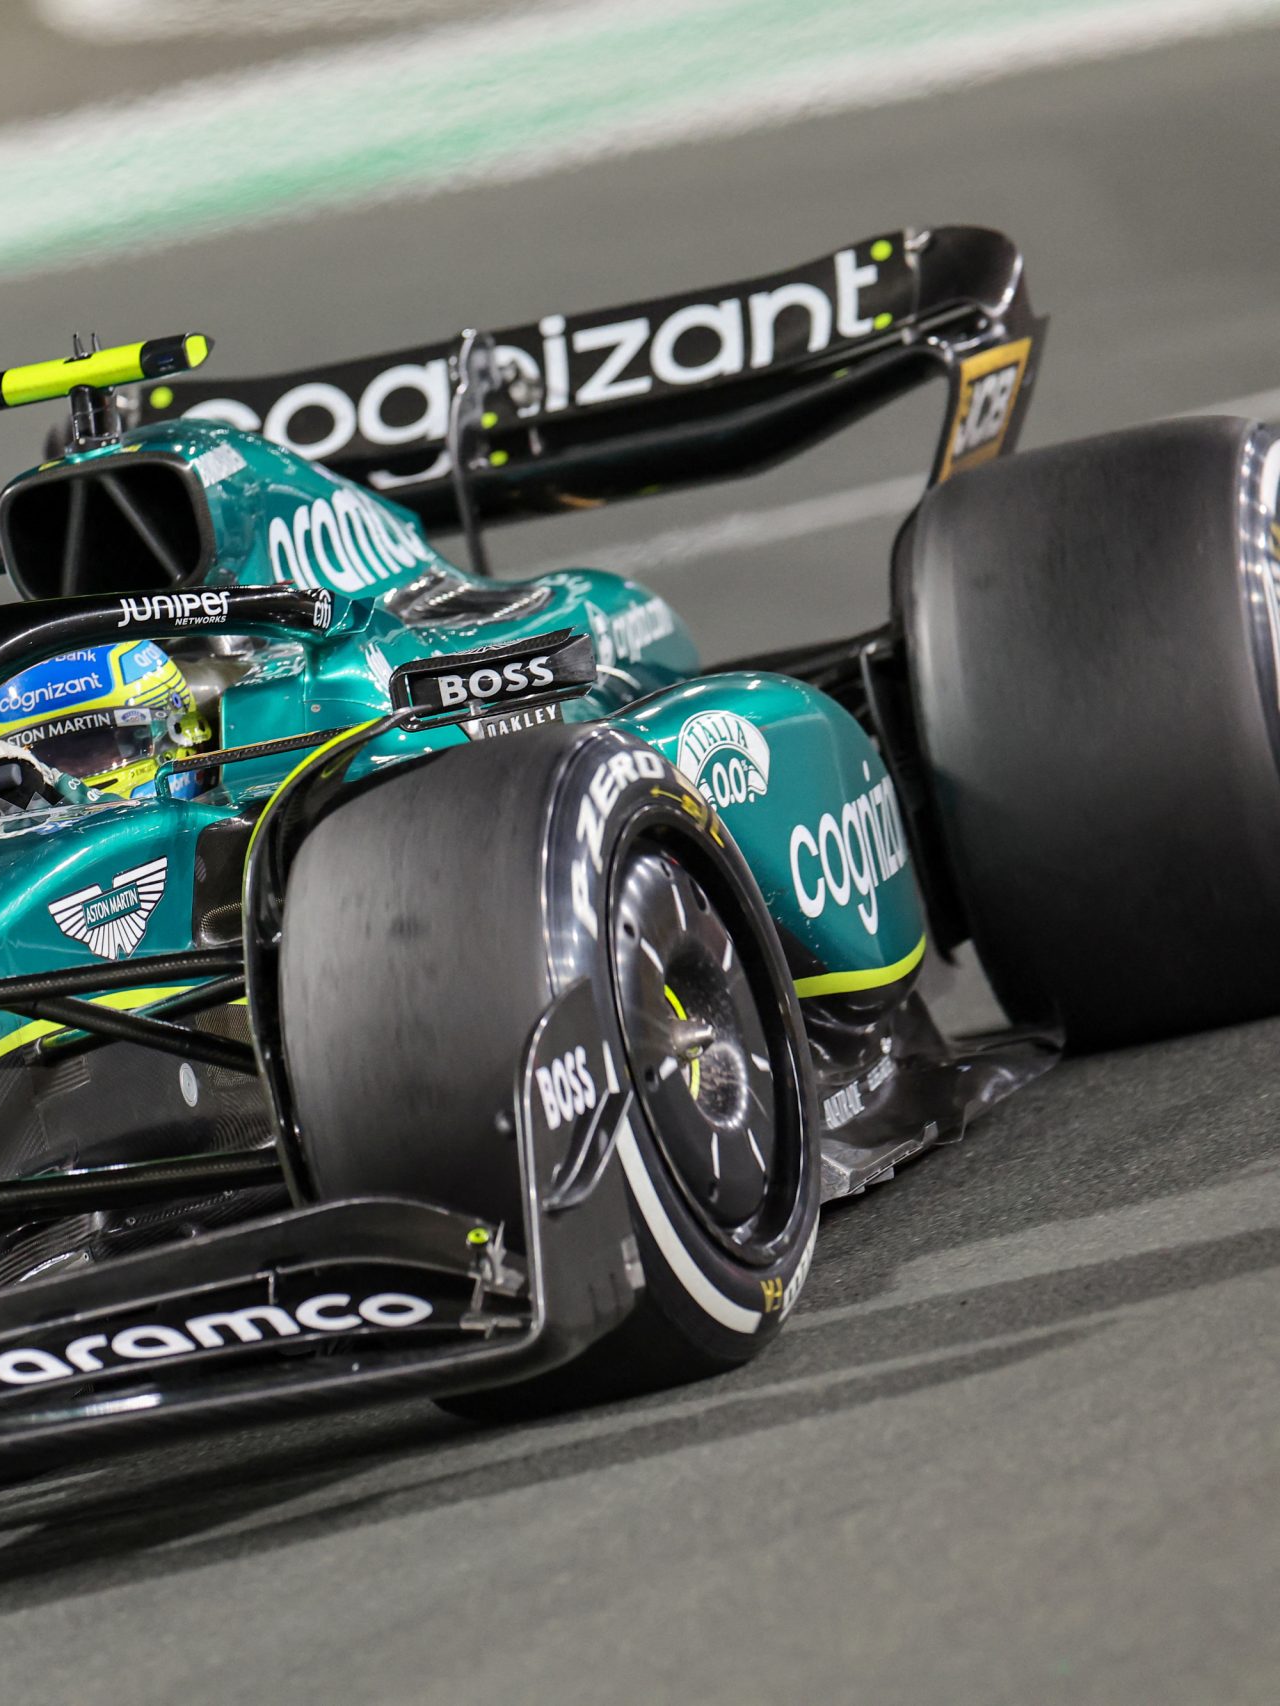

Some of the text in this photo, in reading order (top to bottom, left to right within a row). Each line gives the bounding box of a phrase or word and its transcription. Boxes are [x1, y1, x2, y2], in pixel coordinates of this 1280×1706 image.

[174, 614, 227, 627] NETWORKS
[437, 655, 554, 708] BOSS
[6, 727, 45, 748] STON
[48, 712, 112, 738] MARTIN
[487, 704, 559, 739] OAKLEY
[684, 716, 749, 766] ITALIA
[576, 750, 666, 876] ZERO
[86, 888, 139, 925] ASTON MARTIN
[535, 1045, 597, 1131] BOSS
